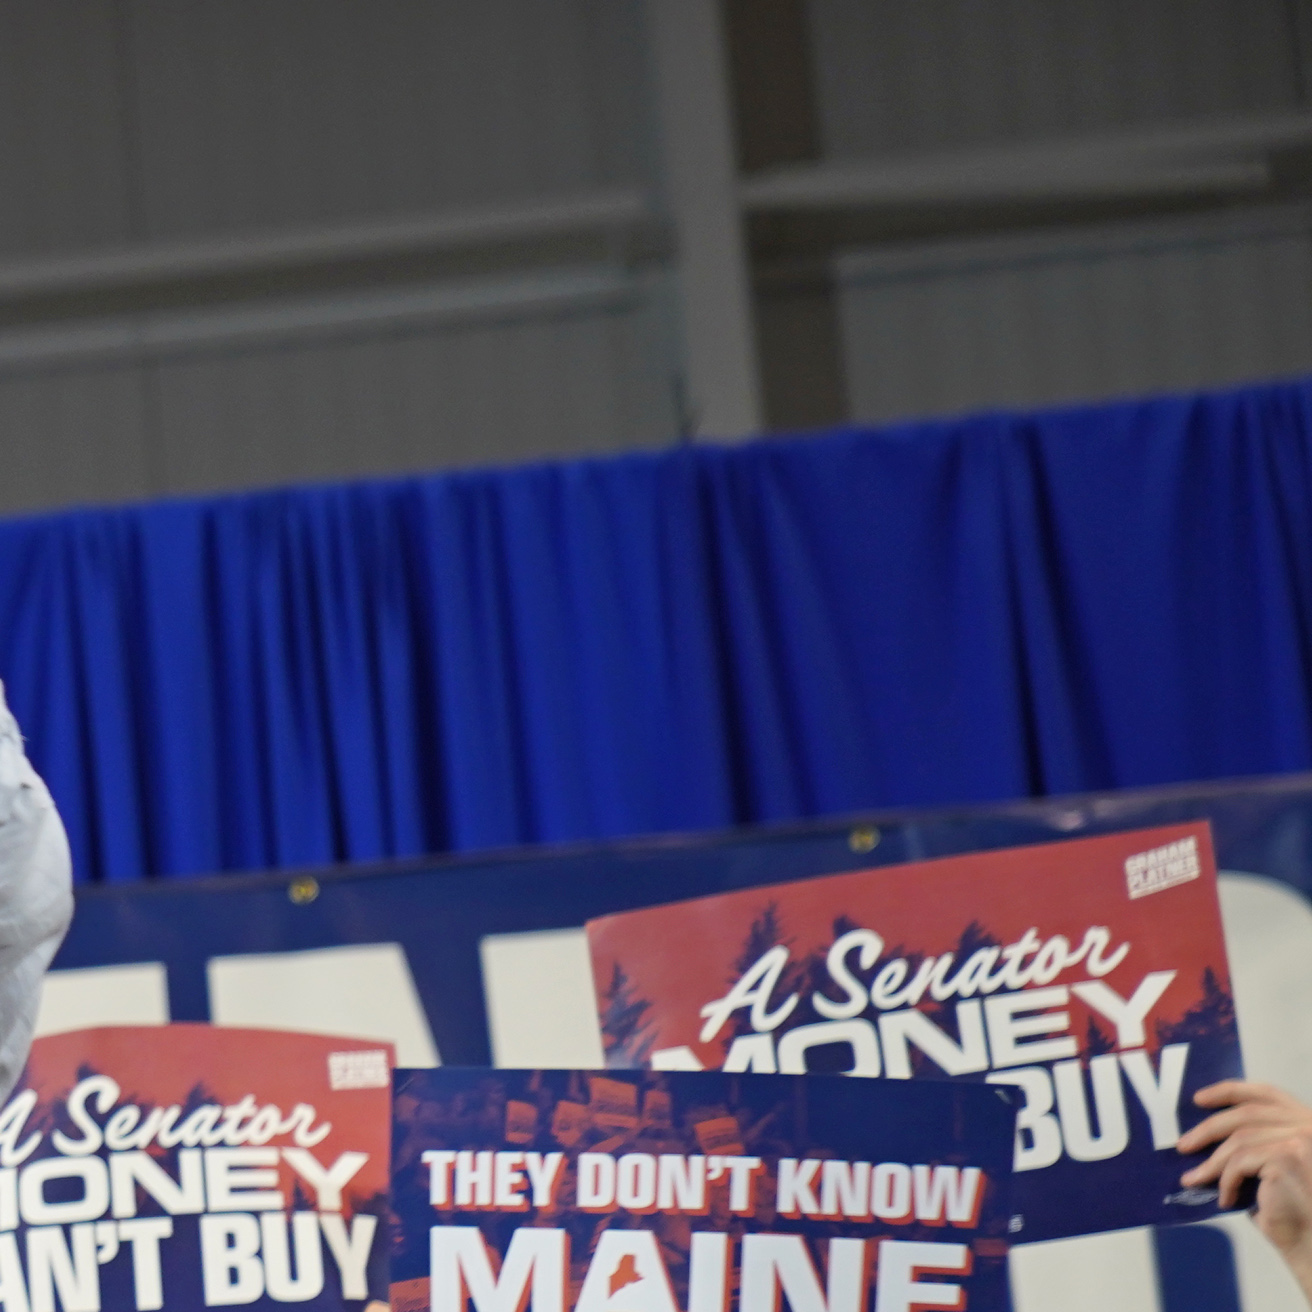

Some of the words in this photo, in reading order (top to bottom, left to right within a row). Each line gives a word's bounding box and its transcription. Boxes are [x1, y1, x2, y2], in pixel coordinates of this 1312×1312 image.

[700, 946, 798, 1043] A
[812, 926, 1130, 1020] Senator
[53, 1075, 331, 1157] Senator
[987, 1043, 1190, 1172] BUY
[422, 1150, 565, 1209] THEY
[578, 1152, 763, 1215] DON'T
[777, 1158, 983, 1225] KNOW
[200, 1211, 377, 1307] BUY
